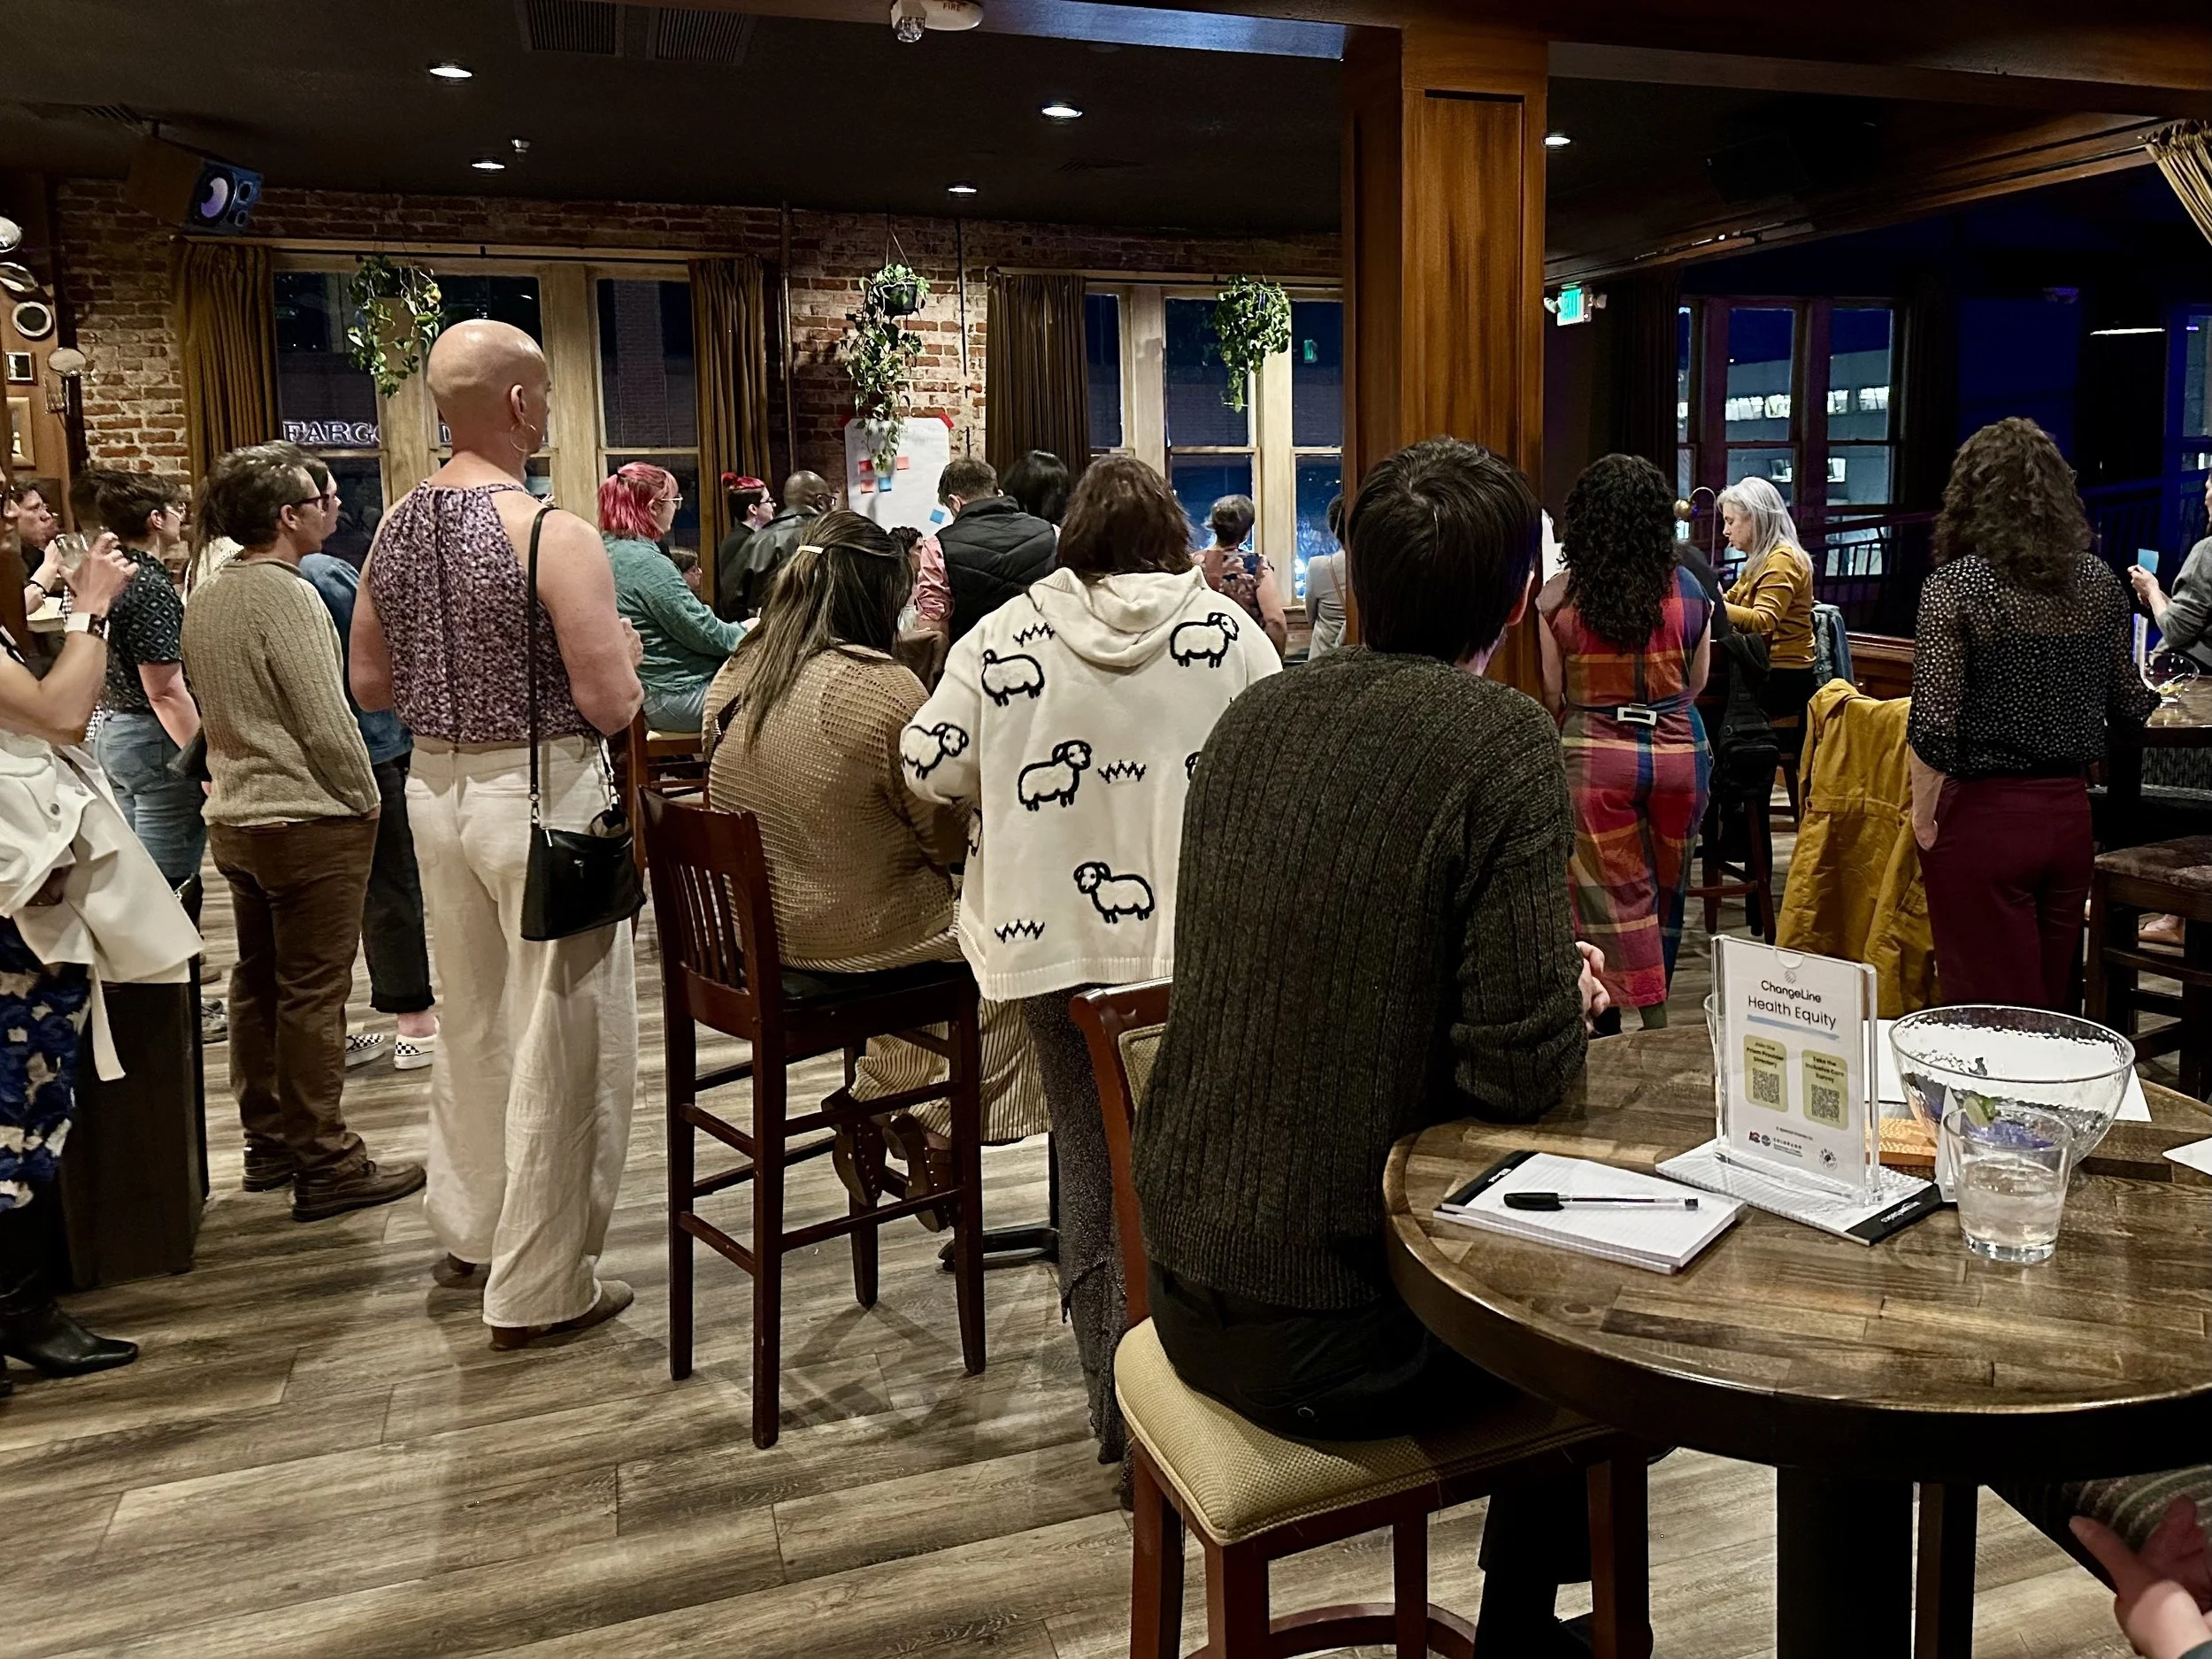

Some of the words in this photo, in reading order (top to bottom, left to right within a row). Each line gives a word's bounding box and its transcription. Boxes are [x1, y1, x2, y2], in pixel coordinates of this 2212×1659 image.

[1761, 979, 1822, 1003] ChangeLine
[1748, 995, 1791, 1017] Health
[1795, 1006, 1836, 1031] Equity
[1763, 1050, 1784, 1061] Provider
[1812, 1056, 1826, 1064] Take
[1805, 1063, 1830, 1073] Inclusive
